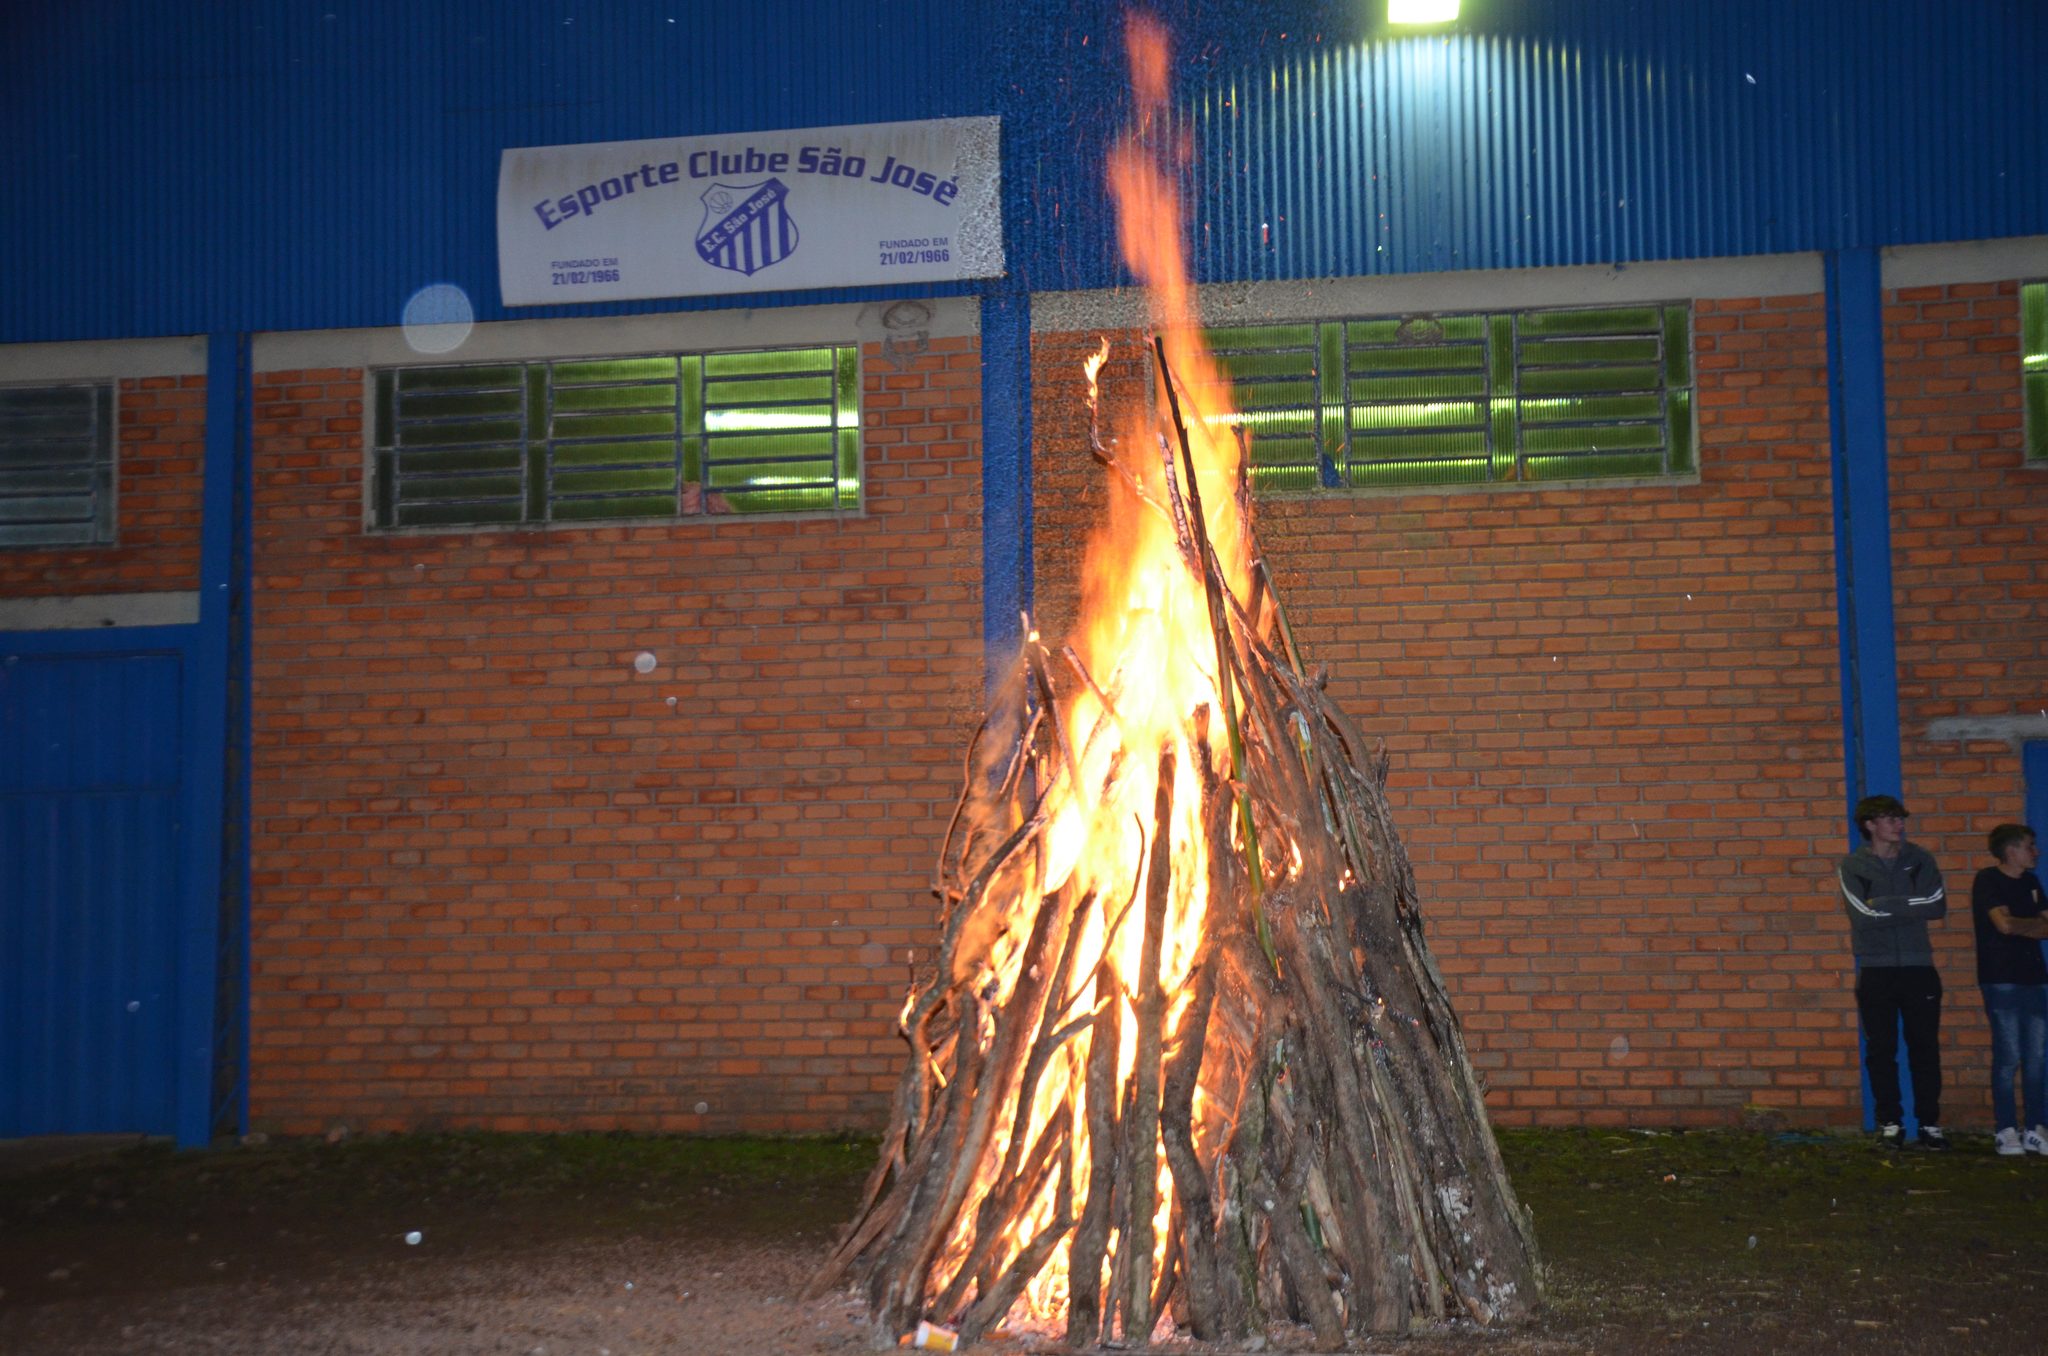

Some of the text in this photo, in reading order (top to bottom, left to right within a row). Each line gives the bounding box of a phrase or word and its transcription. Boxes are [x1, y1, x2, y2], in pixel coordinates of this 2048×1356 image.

[534, 147, 959, 231] Esporte Clube São José
[880, 237, 948, 249] FUNDADO EM
[551, 257, 618, 269] FUNDADO EM
[880, 249, 949, 265] 21/02/1966
[552, 269, 620, 285] 21/02/1966
